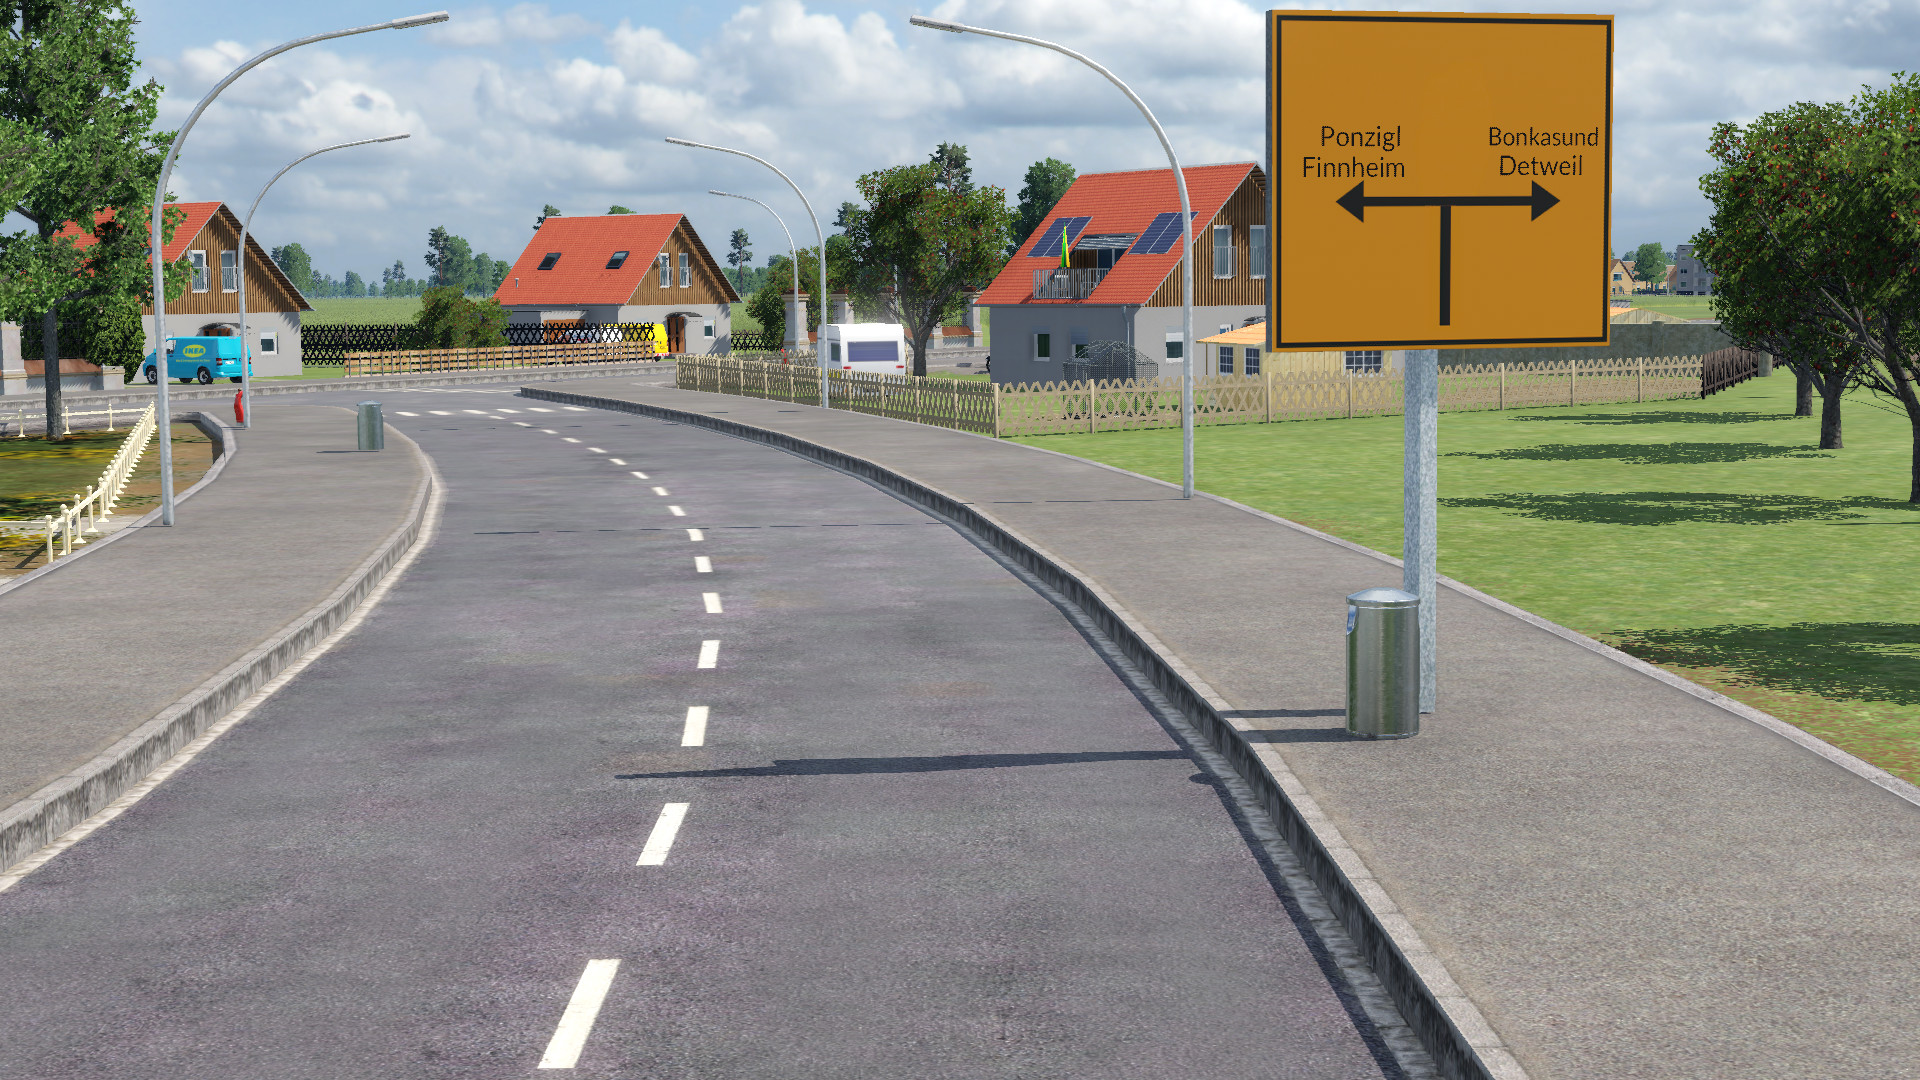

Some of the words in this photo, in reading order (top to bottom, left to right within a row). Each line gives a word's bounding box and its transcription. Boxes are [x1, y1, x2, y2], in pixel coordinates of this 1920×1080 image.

[1321, 125, 1401, 152] Ponzigl
[1489, 126, 1599, 147] Bonkasund
[1303, 156, 1405, 178] Finnheim
[1499, 154, 1583, 176] Detweil
[185, 347, 204, 355] IKEA
